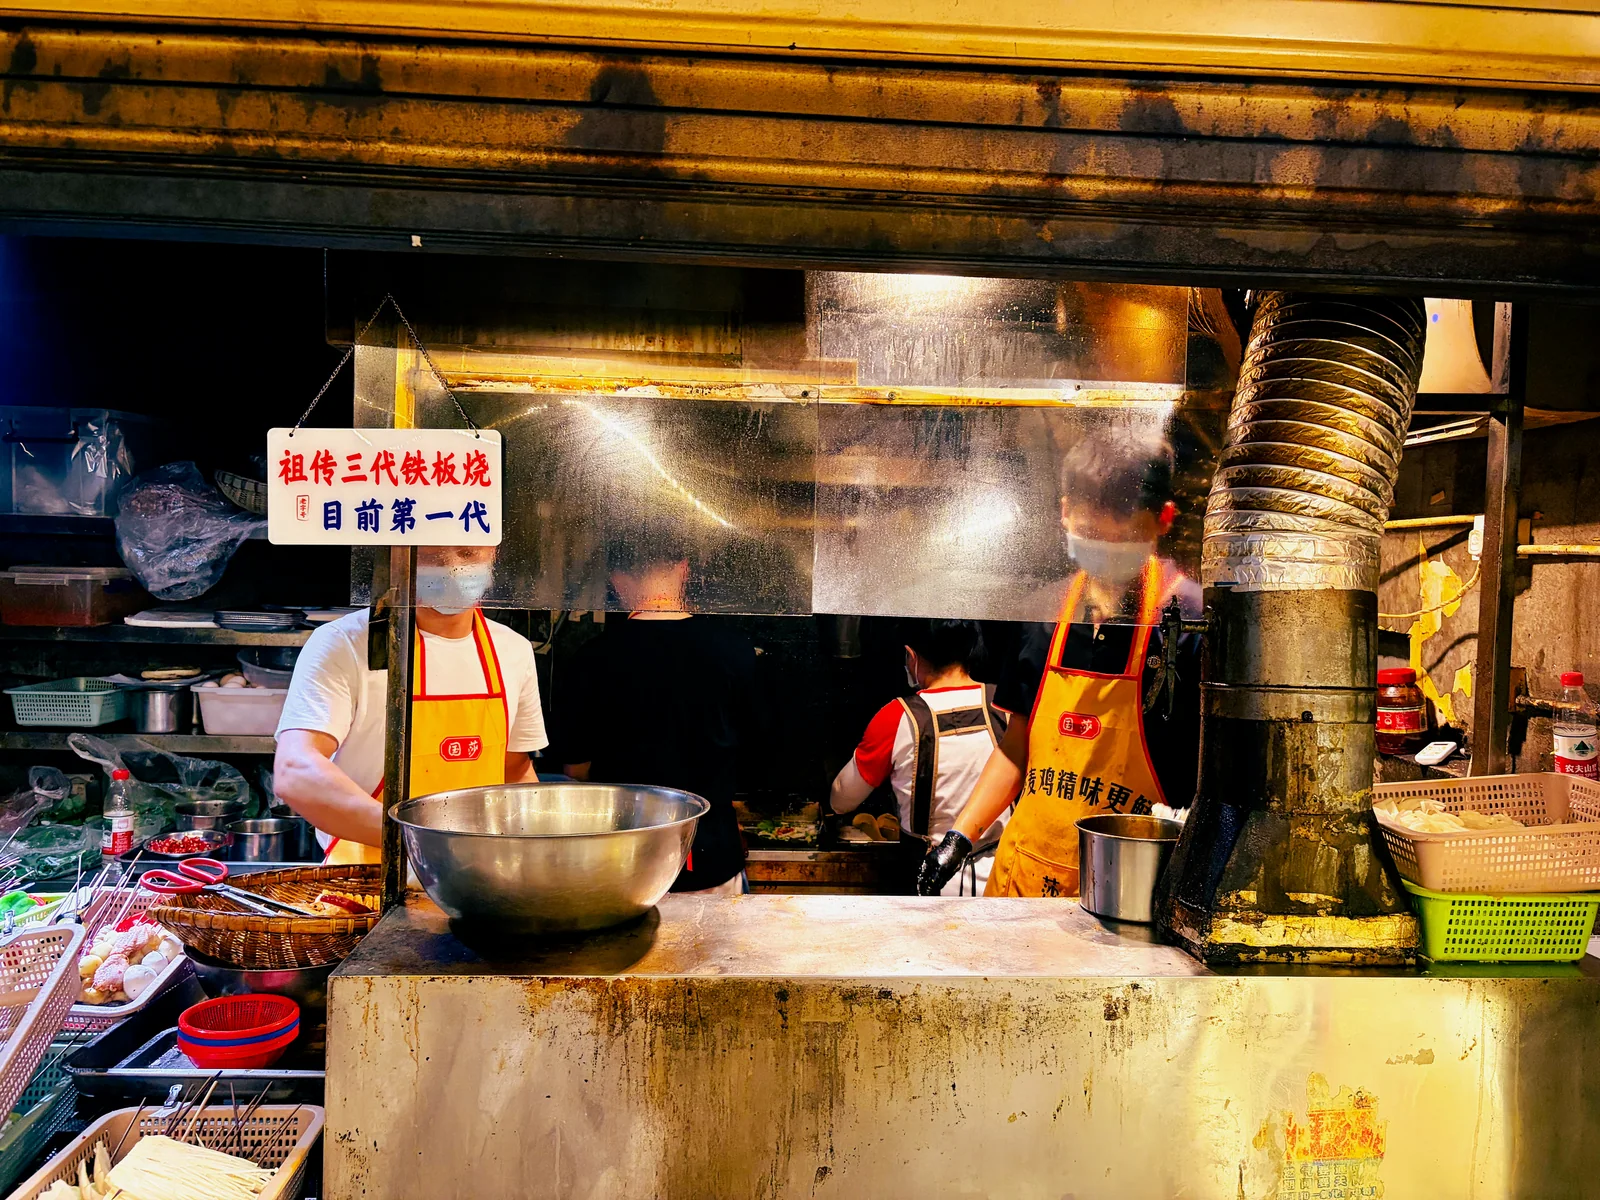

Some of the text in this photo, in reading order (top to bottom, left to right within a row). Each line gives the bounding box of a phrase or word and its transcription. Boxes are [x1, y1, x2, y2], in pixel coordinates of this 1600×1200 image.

[278, 449, 492, 487] 祖传三代铁板烧
[323, 497, 491, 534] 目前第一代
